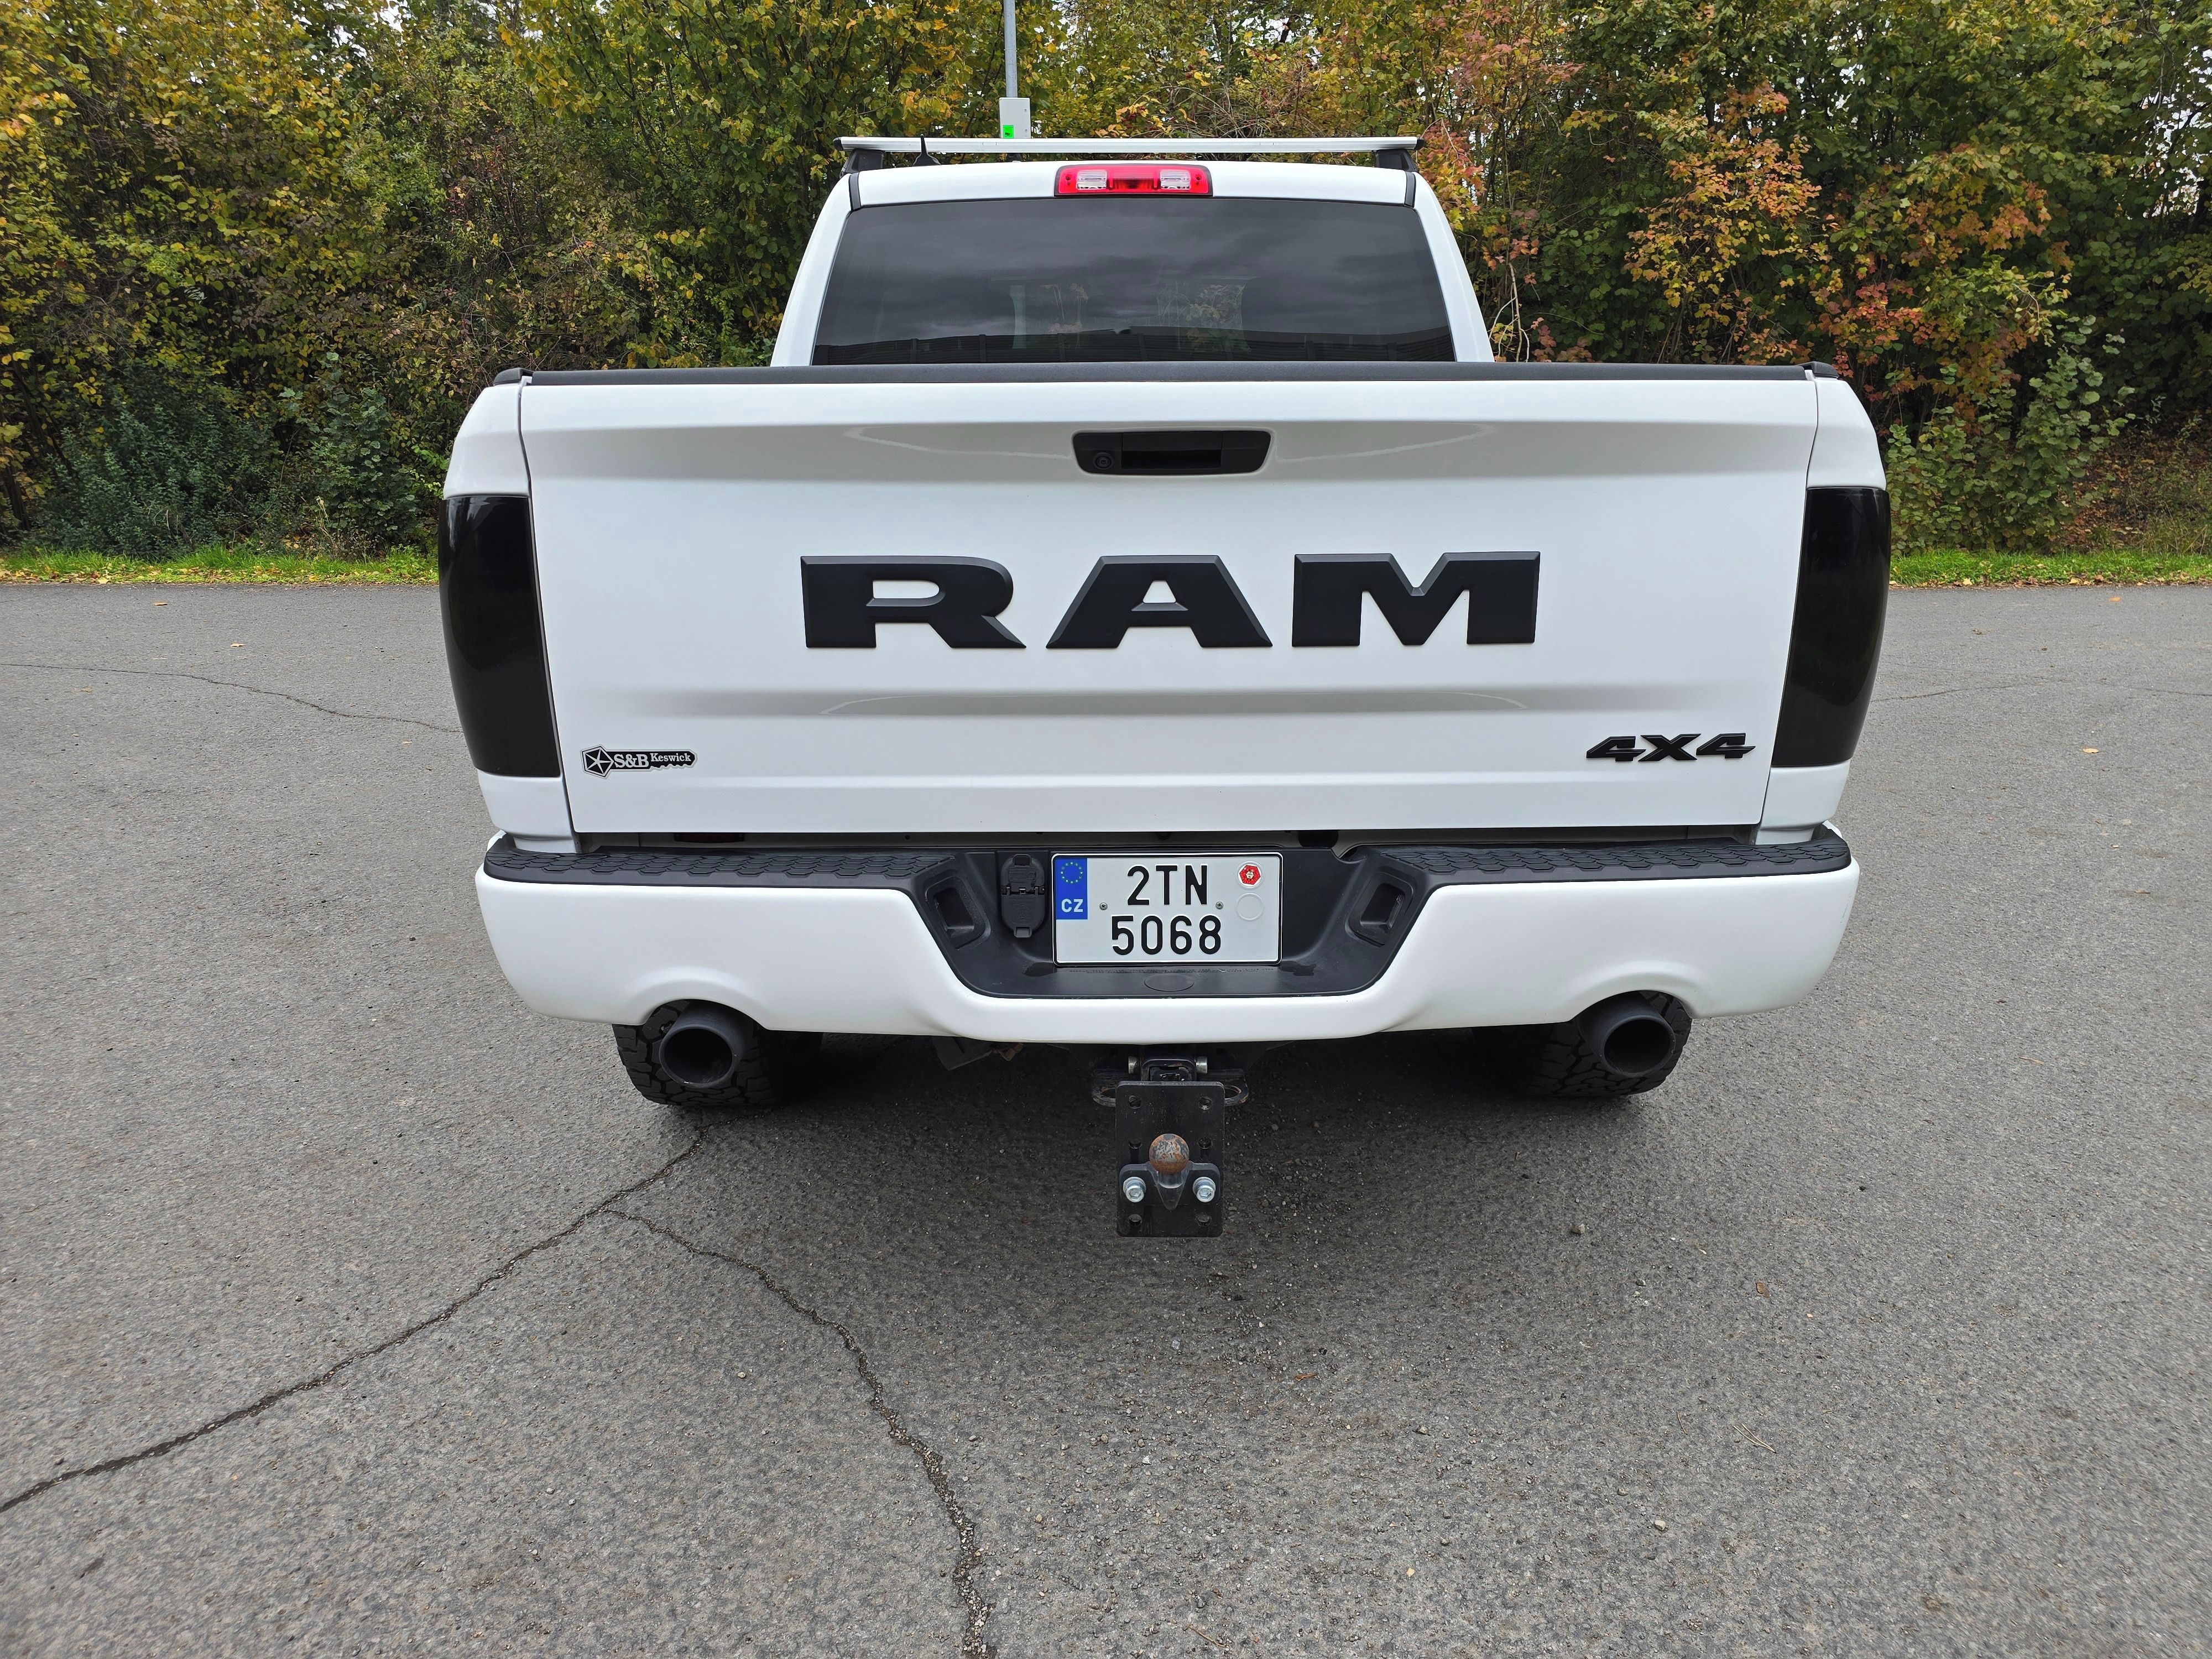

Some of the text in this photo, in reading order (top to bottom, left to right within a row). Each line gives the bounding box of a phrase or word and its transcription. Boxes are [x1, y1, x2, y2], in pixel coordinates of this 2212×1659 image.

[800, 551, 1541, 650] RAM
[614, 753, 692, 768] S&B Keswick
[1585, 732, 1756, 763] 4X4
[1127, 865, 1208, 906] 2TN
[1061, 898, 1083, 913] CZ
[1112, 915, 1221, 956] 5068
